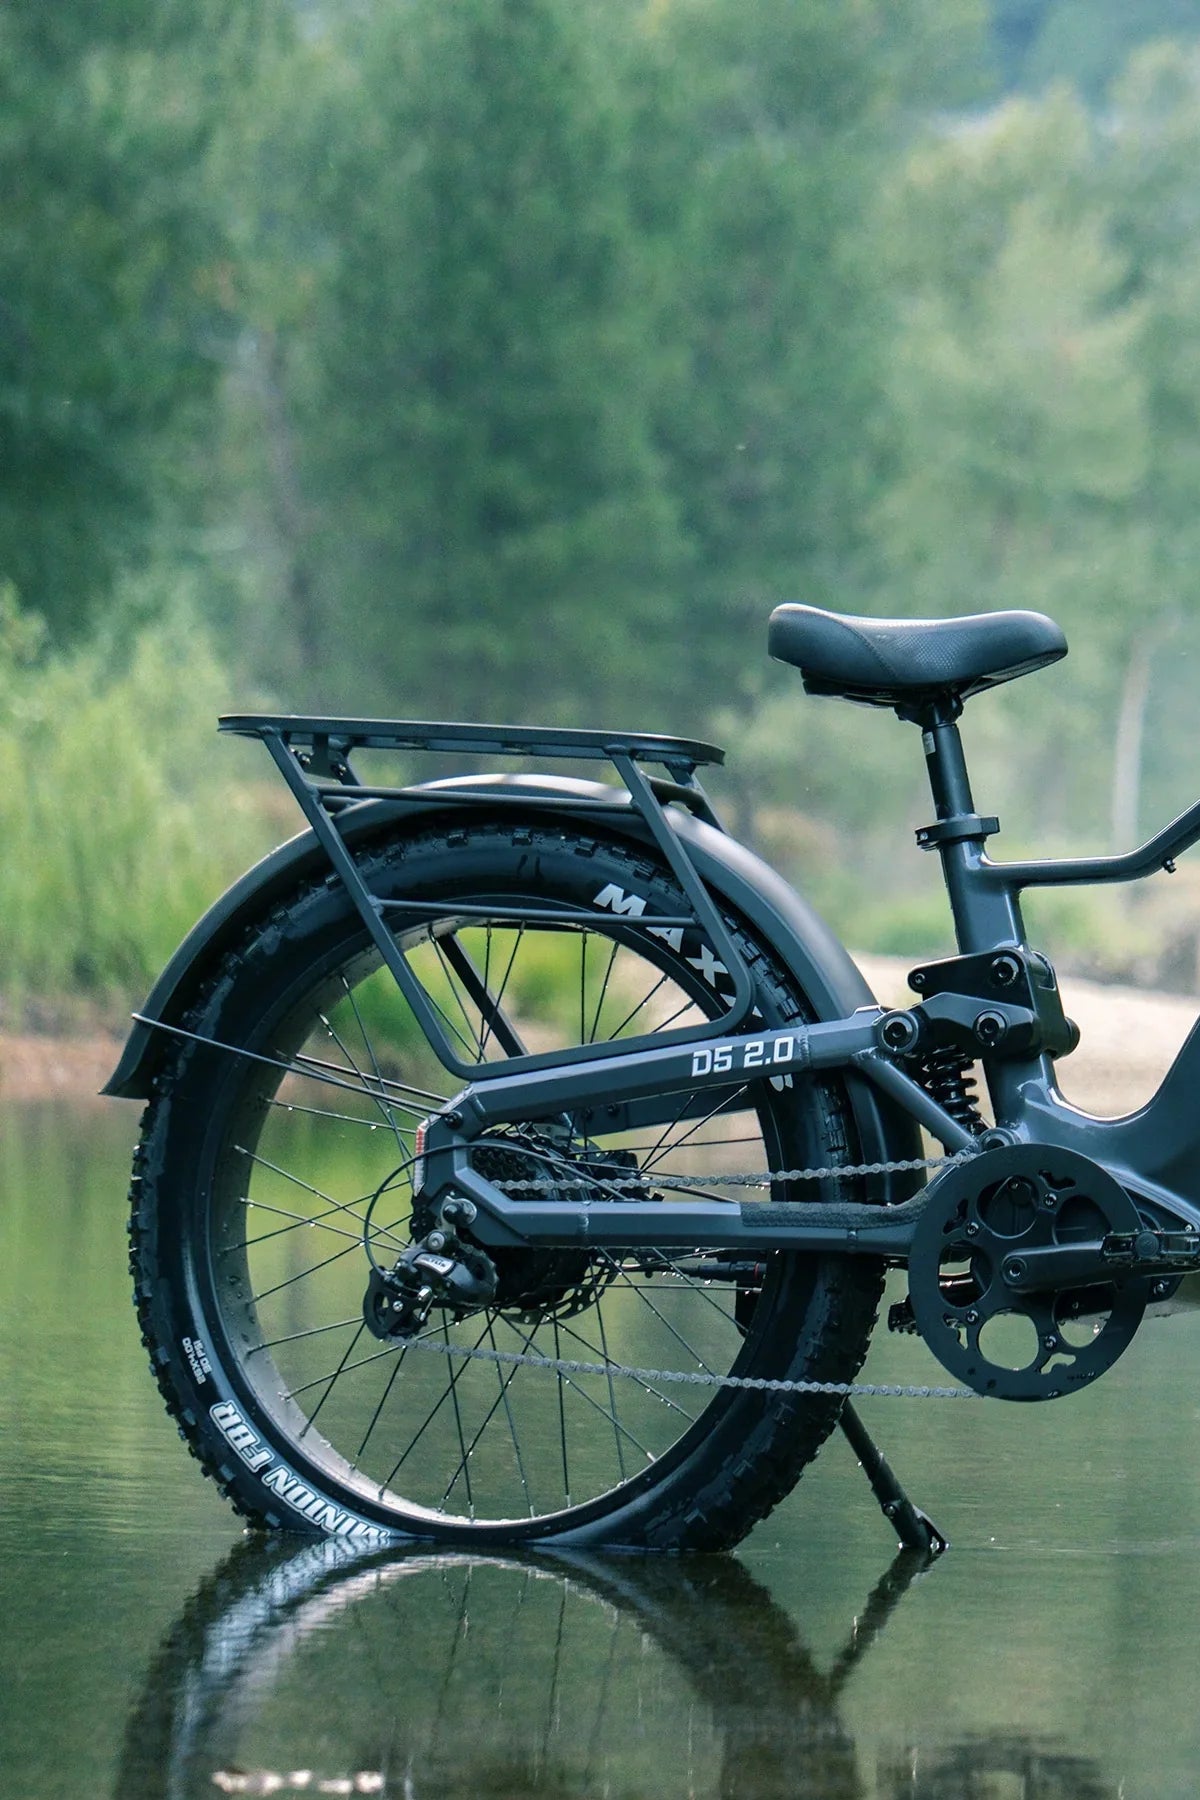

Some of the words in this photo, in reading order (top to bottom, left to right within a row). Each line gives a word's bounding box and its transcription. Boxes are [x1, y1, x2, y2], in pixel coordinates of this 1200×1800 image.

[692, 1045, 733, 1078] D5
[743, 1036, 795, 1063] 2.0
[193, 1339, 206, 1358] PSI
[209, 1400, 276, 1473] FBR
